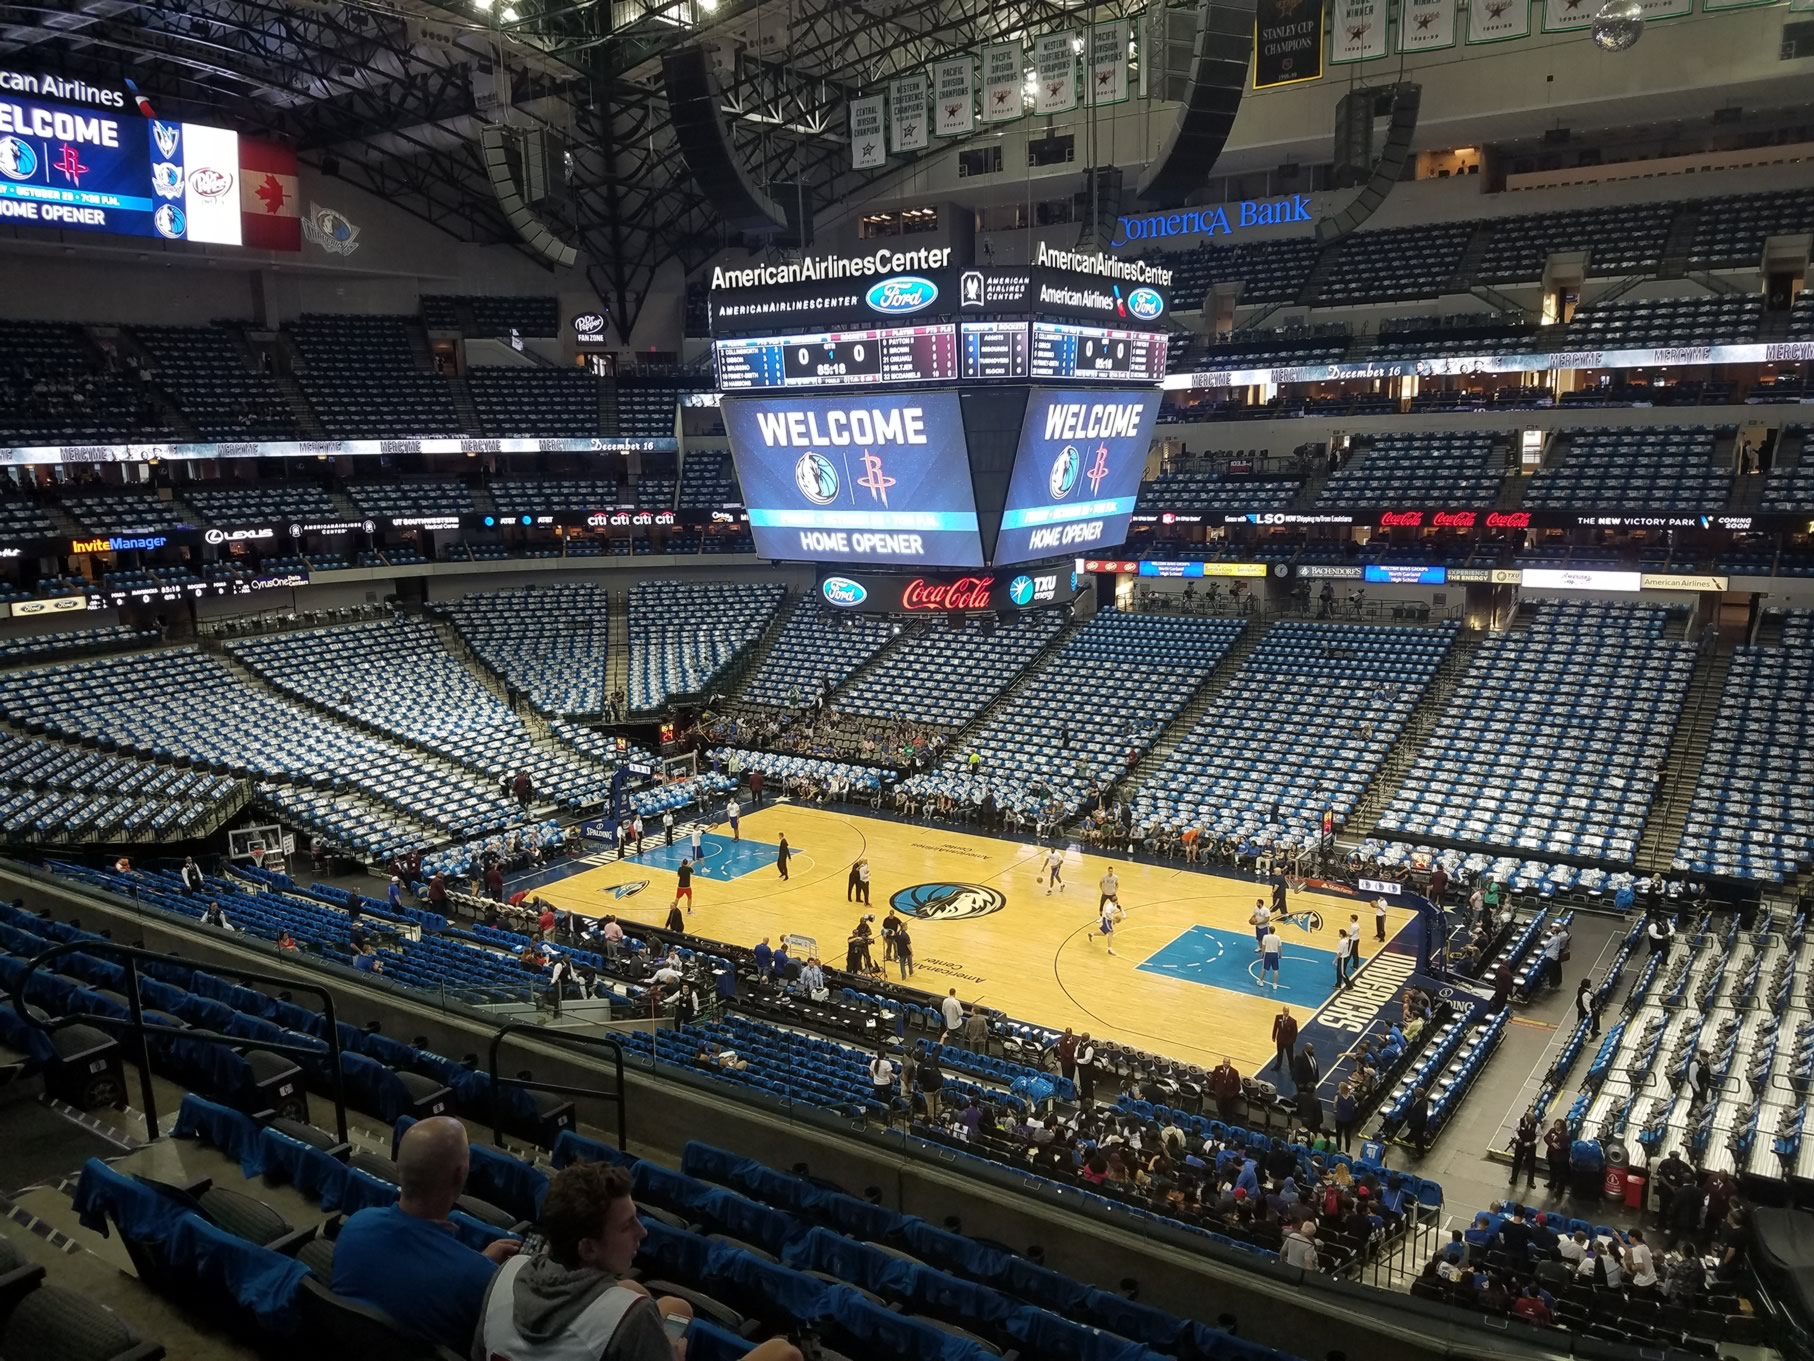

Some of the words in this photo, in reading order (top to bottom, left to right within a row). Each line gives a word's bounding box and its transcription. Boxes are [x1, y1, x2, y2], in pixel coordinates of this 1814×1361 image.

[1346, 5, 1375, 19] WINNER
[1262, 21, 1297, 41] STANLEY
[1297, 20, 1315, 34] CUP
[1264, 37, 1313, 57] CHAMPIONS
[991, 50, 1013, 63] PACIFIC
[942, 66, 964, 78] PACIFIC
[987, 72, 1018, 86] CHAMPIONS
[942, 77, 965, 89] DIVISION
[42, 74, 125, 107] Airlines
[939, 87, 969, 100] CHAMPIONS
[856, 105, 878, 118] CENTRAL
[894, 102, 924, 116] CHAMPIONS
[857, 116, 877, 127] DIVISION
[854, 125, 881, 138] CHAMPIONS
[41, 205, 106, 225] OPENER
[1240, 194, 1313, 227] Bank
[986, 276, 1030, 285] AMERICAN
[986, 284, 1026, 293] AIRLINES
[986, 292, 1021, 300] CENTER
[1040, 284, 1082, 307] American
[1082, 289, 1114, 312] Airlines
[578, 318, 602, 332] Pepper
[585, 315, 595, 324] Dr
[578, 334, 589, 342] FAN
[589, 334, 604, 342] ZONE
[853, 344, 865, 362] 0
[1086, 340, 1093, 357] 0
[1653, 347, 1710, 363] MERCYME
[798, 348, 809, 365] 0
[1550, 352, 1602, 368] MERCYME
[817, 362, 846, 376] 85:18
[1326, 363, 1385, 381] December
[1388, 365, 1400, 377] 16
[1191, 372, 1233, 388] MERCYME
[756, 407, 928, 448] WELCOME
[1044, 403, 1144, 441] WELCOME
[299, 440, 342, 454] MERCYME
[380, 439, 422, 454] MERCYME
[460, 439, 502, 453] MERCYME
[590, 437, 641, 453] December
[643, 441, 655, 451] 16
[60, 446, 108, 462] MERCYME
[392, 518, 402, 526] UT
[403, 517, 459, 526] SOUTHWESTERN
[500, 517, 516, 525] AT&T
[538, 516, 554, 525] AT&T
[588, 514, 607, 526] citi
[610, 514, 630, 526] citi
[632, 513, 652, 526] citi
[655, 513, 675, 525] citi
[1256, 513, 1285, 524] LSO
[1296, 515, 1314, 523] Shipping
[1381, 511, 1423, 527] Coca-Cola
[1433, 511, 1477, 527] Coca-Cola
[1486, 511, 1532, 527] Coca-Cola
[1577, 517, 1596, 525] THE
[1597, 517, 1621, 525] NEW
[1623, 517, 1667, 526] VICTORY
[1669, 518, 1695, 526] PARK
[443, 522, 459, 530] Center
[223, 528, 274, 541] LEXUS
[1028, 526, 1062, 551] HOME
[1062, 520, 1104, 545] OPENER
[72, 536, 167, 554] InviteManager
[800, 531, 850, 552] HOME
[852, 533, 925, 555] OPENER
[1311, 566, 1361, 575] BACHENDORF'S
[161, 585, 181, 593] 85:18
[251, 578, 289, 591] CyrusOne
[289, 579, 309, 587] Centers
[1034, 575, 1057, 592] TXU
[1644, 578, 1680, 587] American
[1681, 579, 1710, 588] Airlines
[903, 576, 995, 610] Coca-Cola
[1034, 588, 1056, 601] energy
[663, 731, 673, 740] 24
[586, 827, 613, 840] SPALDING
[922, 957, 963, 971] Center
[1317, 951, 1418, 1034] MAVERICKS
